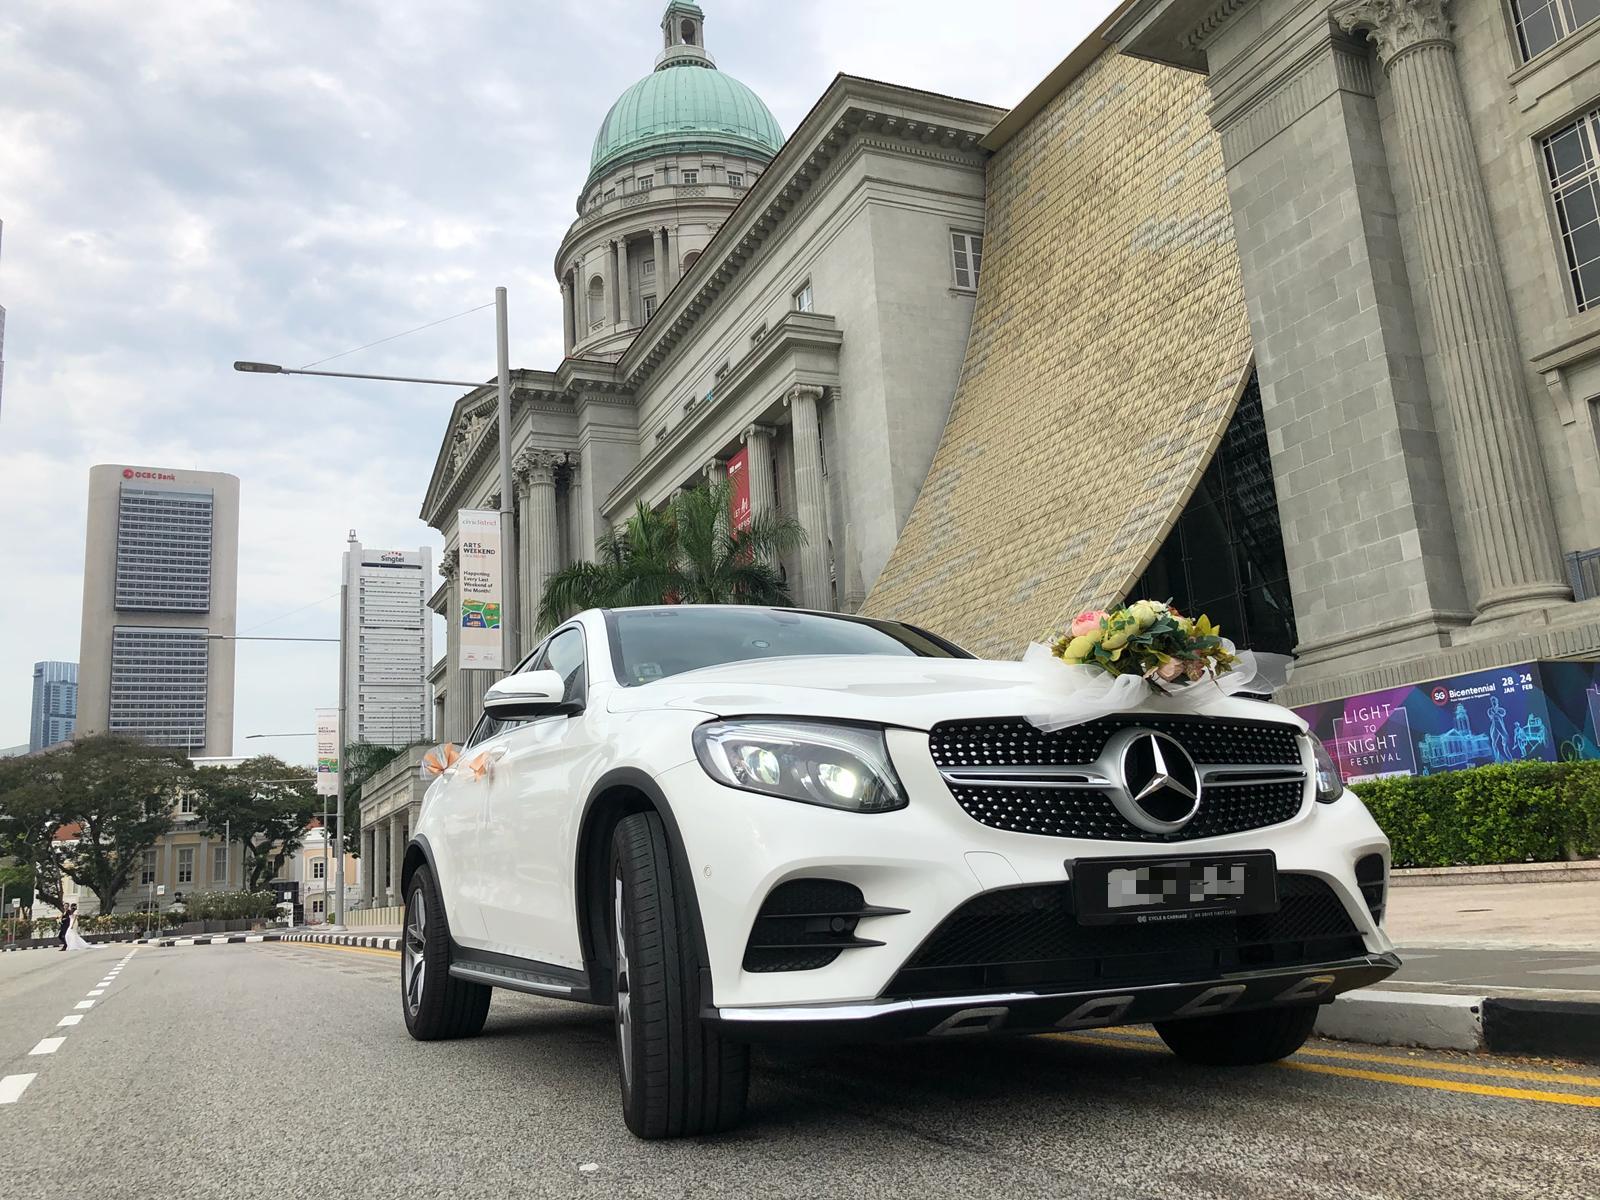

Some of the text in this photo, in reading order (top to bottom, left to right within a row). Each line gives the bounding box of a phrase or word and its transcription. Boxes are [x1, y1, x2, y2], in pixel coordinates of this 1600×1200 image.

[135, 471, 176, 481] OCBC Bank
[380, 554, 404, 564] Singtel
[1502, 676, 1514, 687] 28
[1520, 674, 1532, 684] 24
[1434, 692, 1446, 701] SG
[1449, 683, 1496, 698] Bicentennial
[1504, 683, 1534, 694] JAN FEB
[1344, 704, 1391, 724] LIGHT
[1364, 724, 1377, 733] TO
[1348, 734, 1398, 754] NIGHT
[1350, 753, 1402, 766] FESTIVAL
